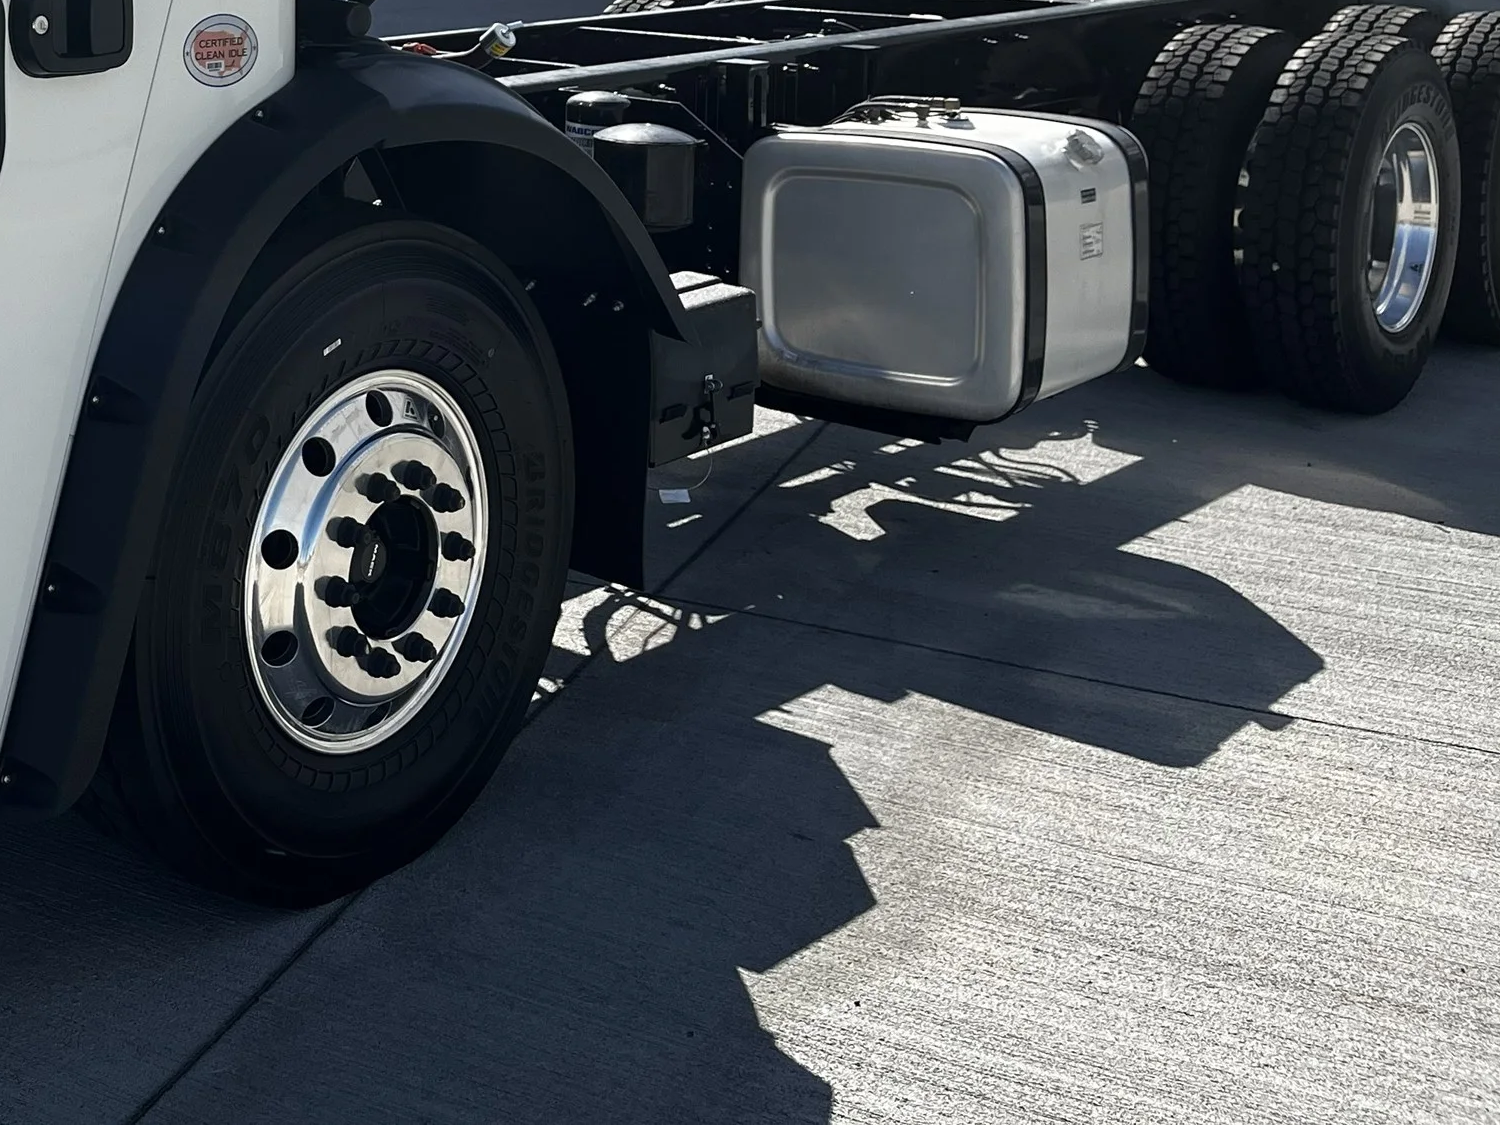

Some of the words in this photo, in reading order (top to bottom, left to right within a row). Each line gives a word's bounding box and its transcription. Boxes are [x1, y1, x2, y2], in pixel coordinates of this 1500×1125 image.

[199, 37, 243, 49] CERTIFIED
[195, 50, 225, 61] CLEAN
[228, 48, 248, 58] IDLE
